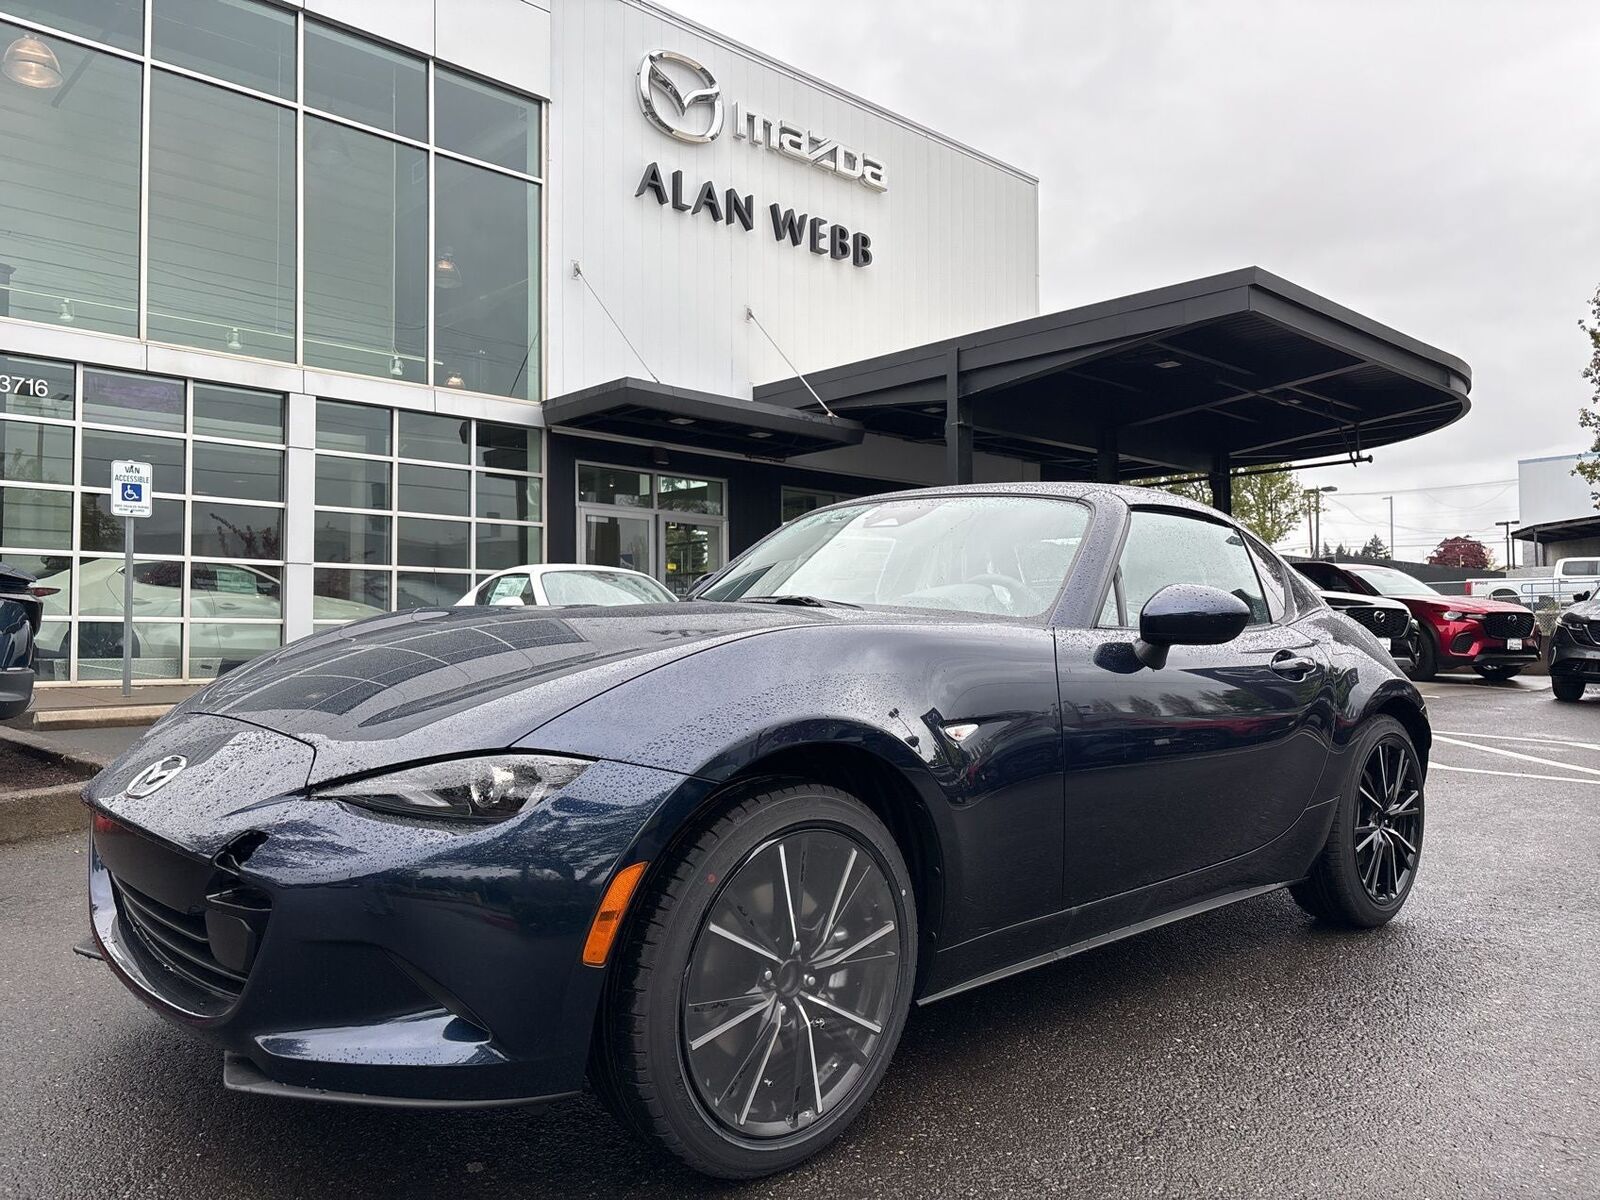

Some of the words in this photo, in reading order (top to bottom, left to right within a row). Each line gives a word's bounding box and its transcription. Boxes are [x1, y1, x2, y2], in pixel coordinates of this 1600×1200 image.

[634, 161, 754, 232] ALAN
[769, 202, 873, 268] WEBB
[0, 374, 49, 397] 3716
[124, 465, 141, 475] VAN
[114, 474, 150, 484] ACCESSIBLE
